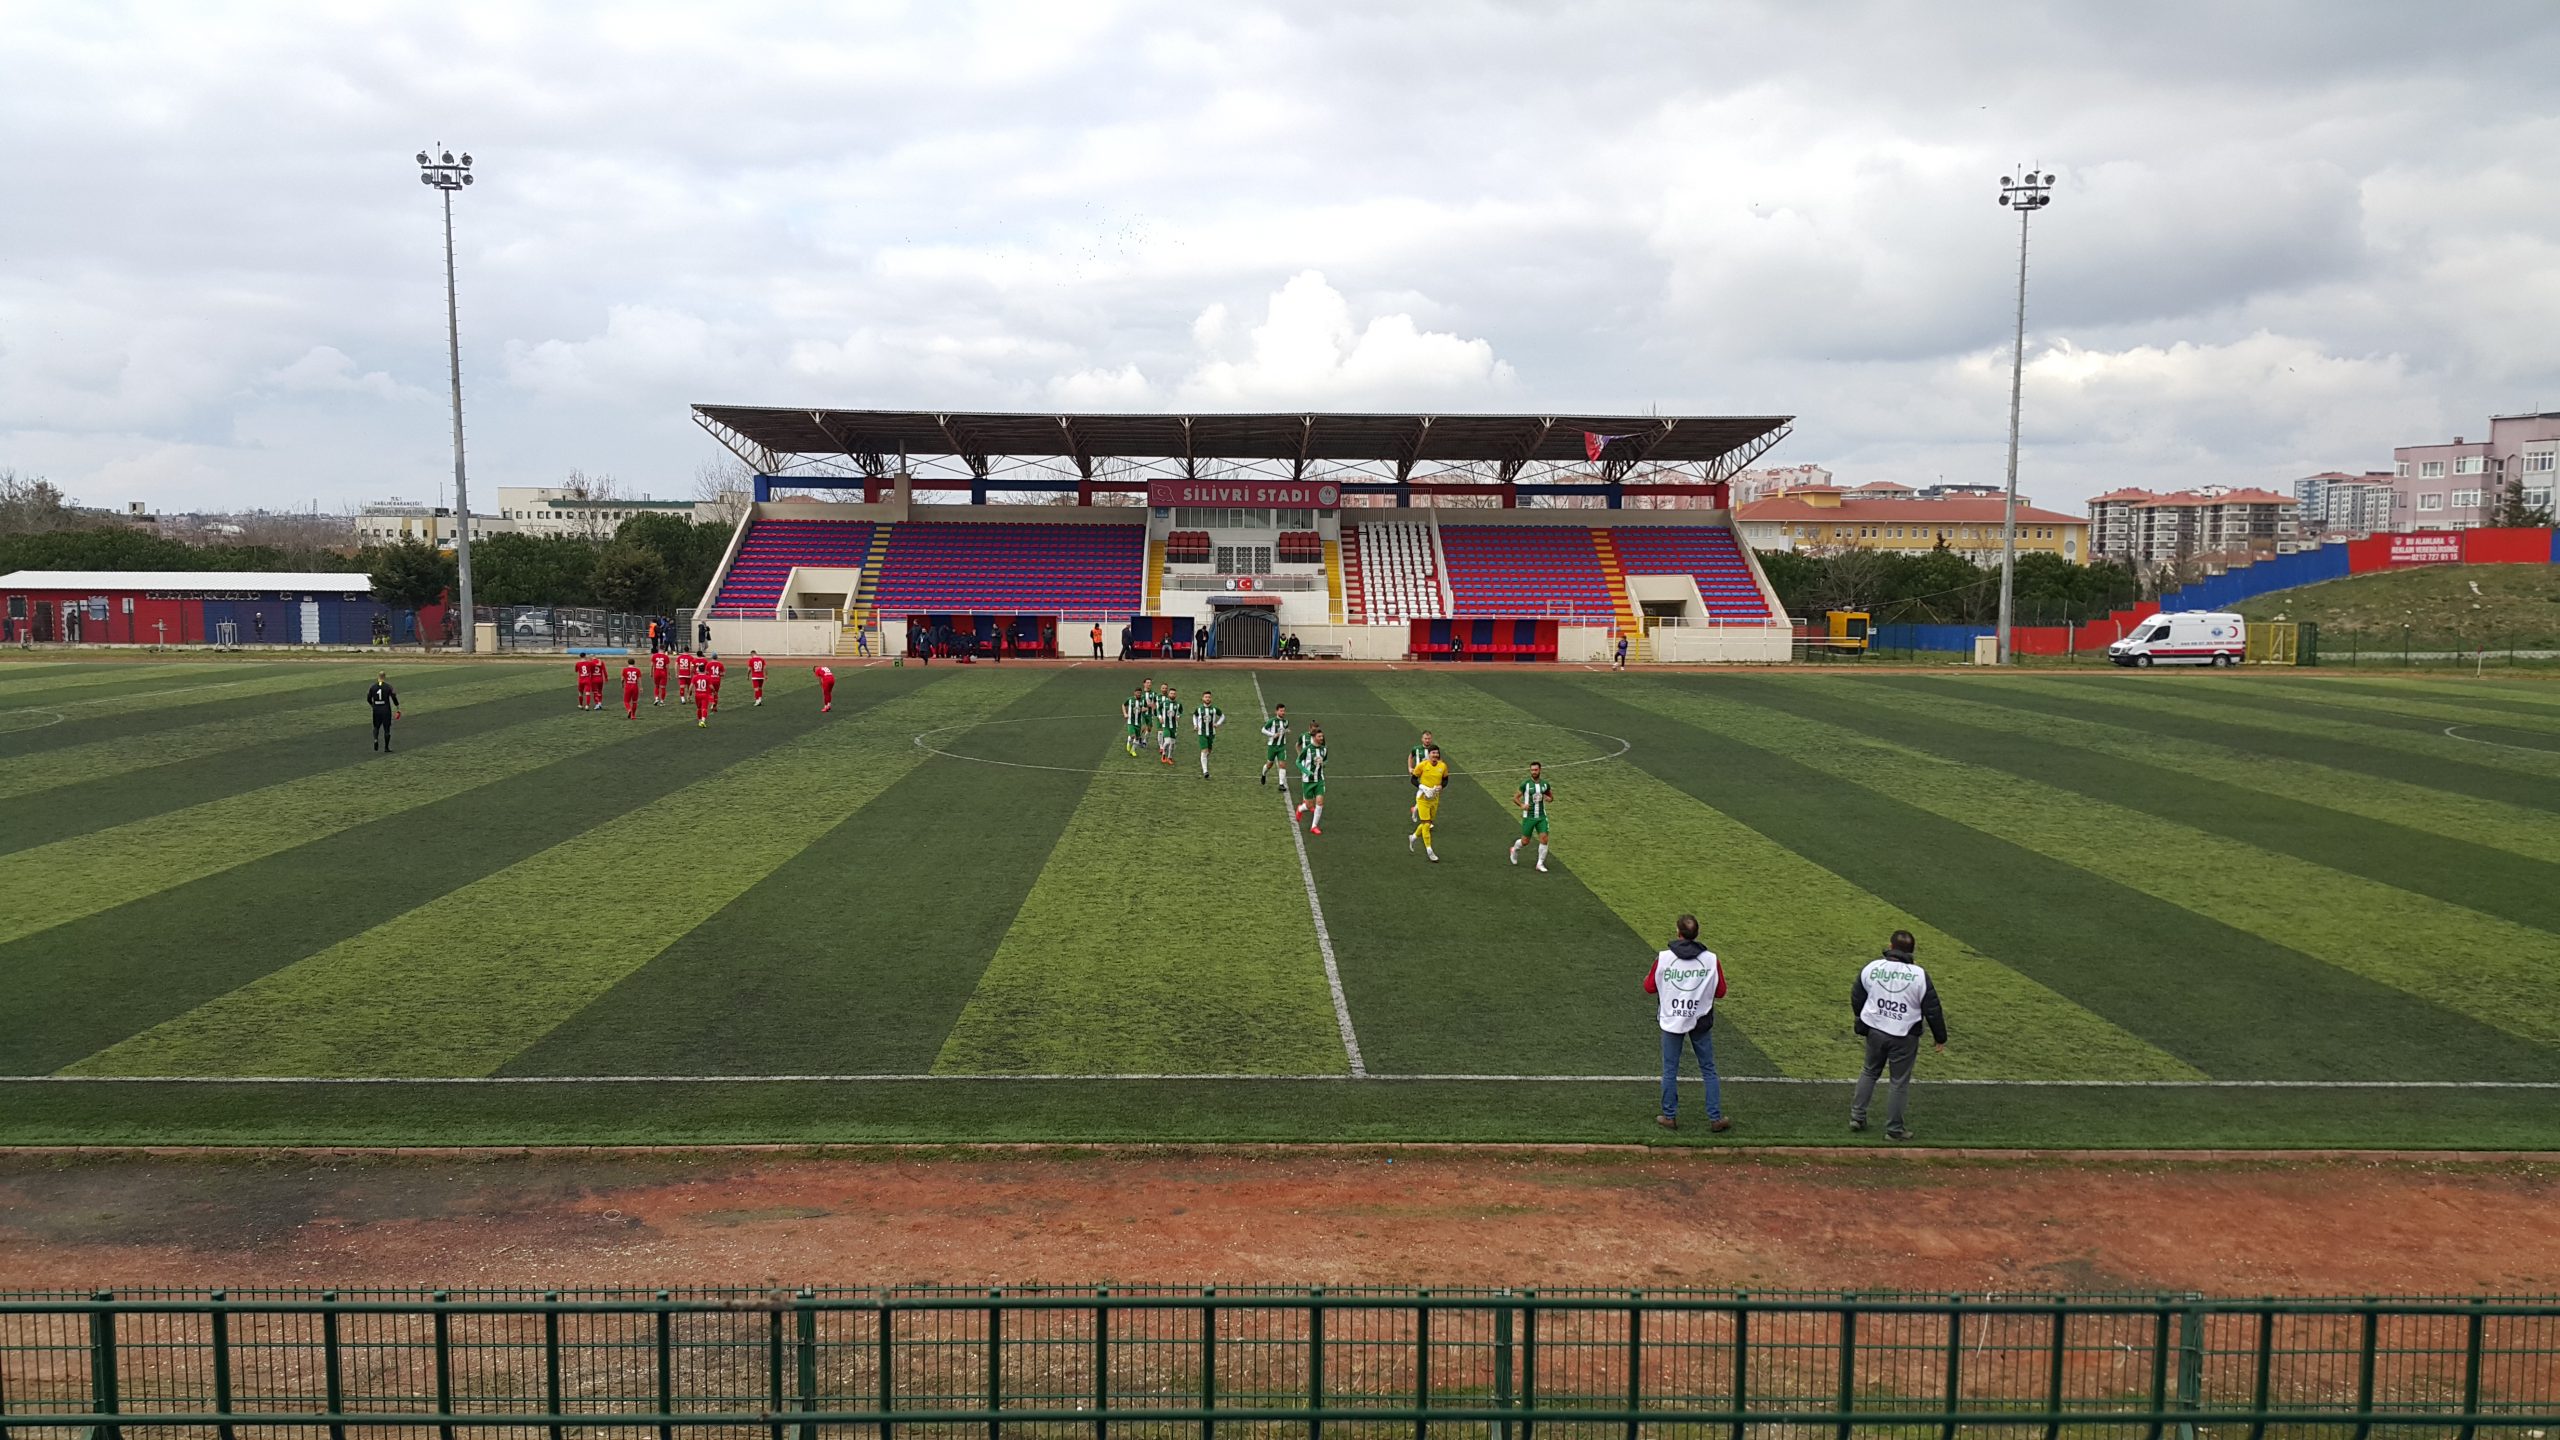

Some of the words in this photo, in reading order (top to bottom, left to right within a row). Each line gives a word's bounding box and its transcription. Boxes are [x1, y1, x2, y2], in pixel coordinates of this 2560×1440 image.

[1183, 484, 1250, 501] SİLİVRİ
[1257, 488, 1310, 502] STADI
[655, 657, 665, 667] 25
[680, 658, 689, 667] 58
[626, 671, 637, 681] 35
[711, 665, 719, 675] 14
[696, 679, 707, 689] 10
[376, 688, 382, 700] 1
[1663, 968, 1711, 982] Bilyoner
[1870, 967, 1919, 982] Bilyoner
[1877, 998, 1908, 1013] 0028
[1879, 1009, 1902, 1021] PRESS
